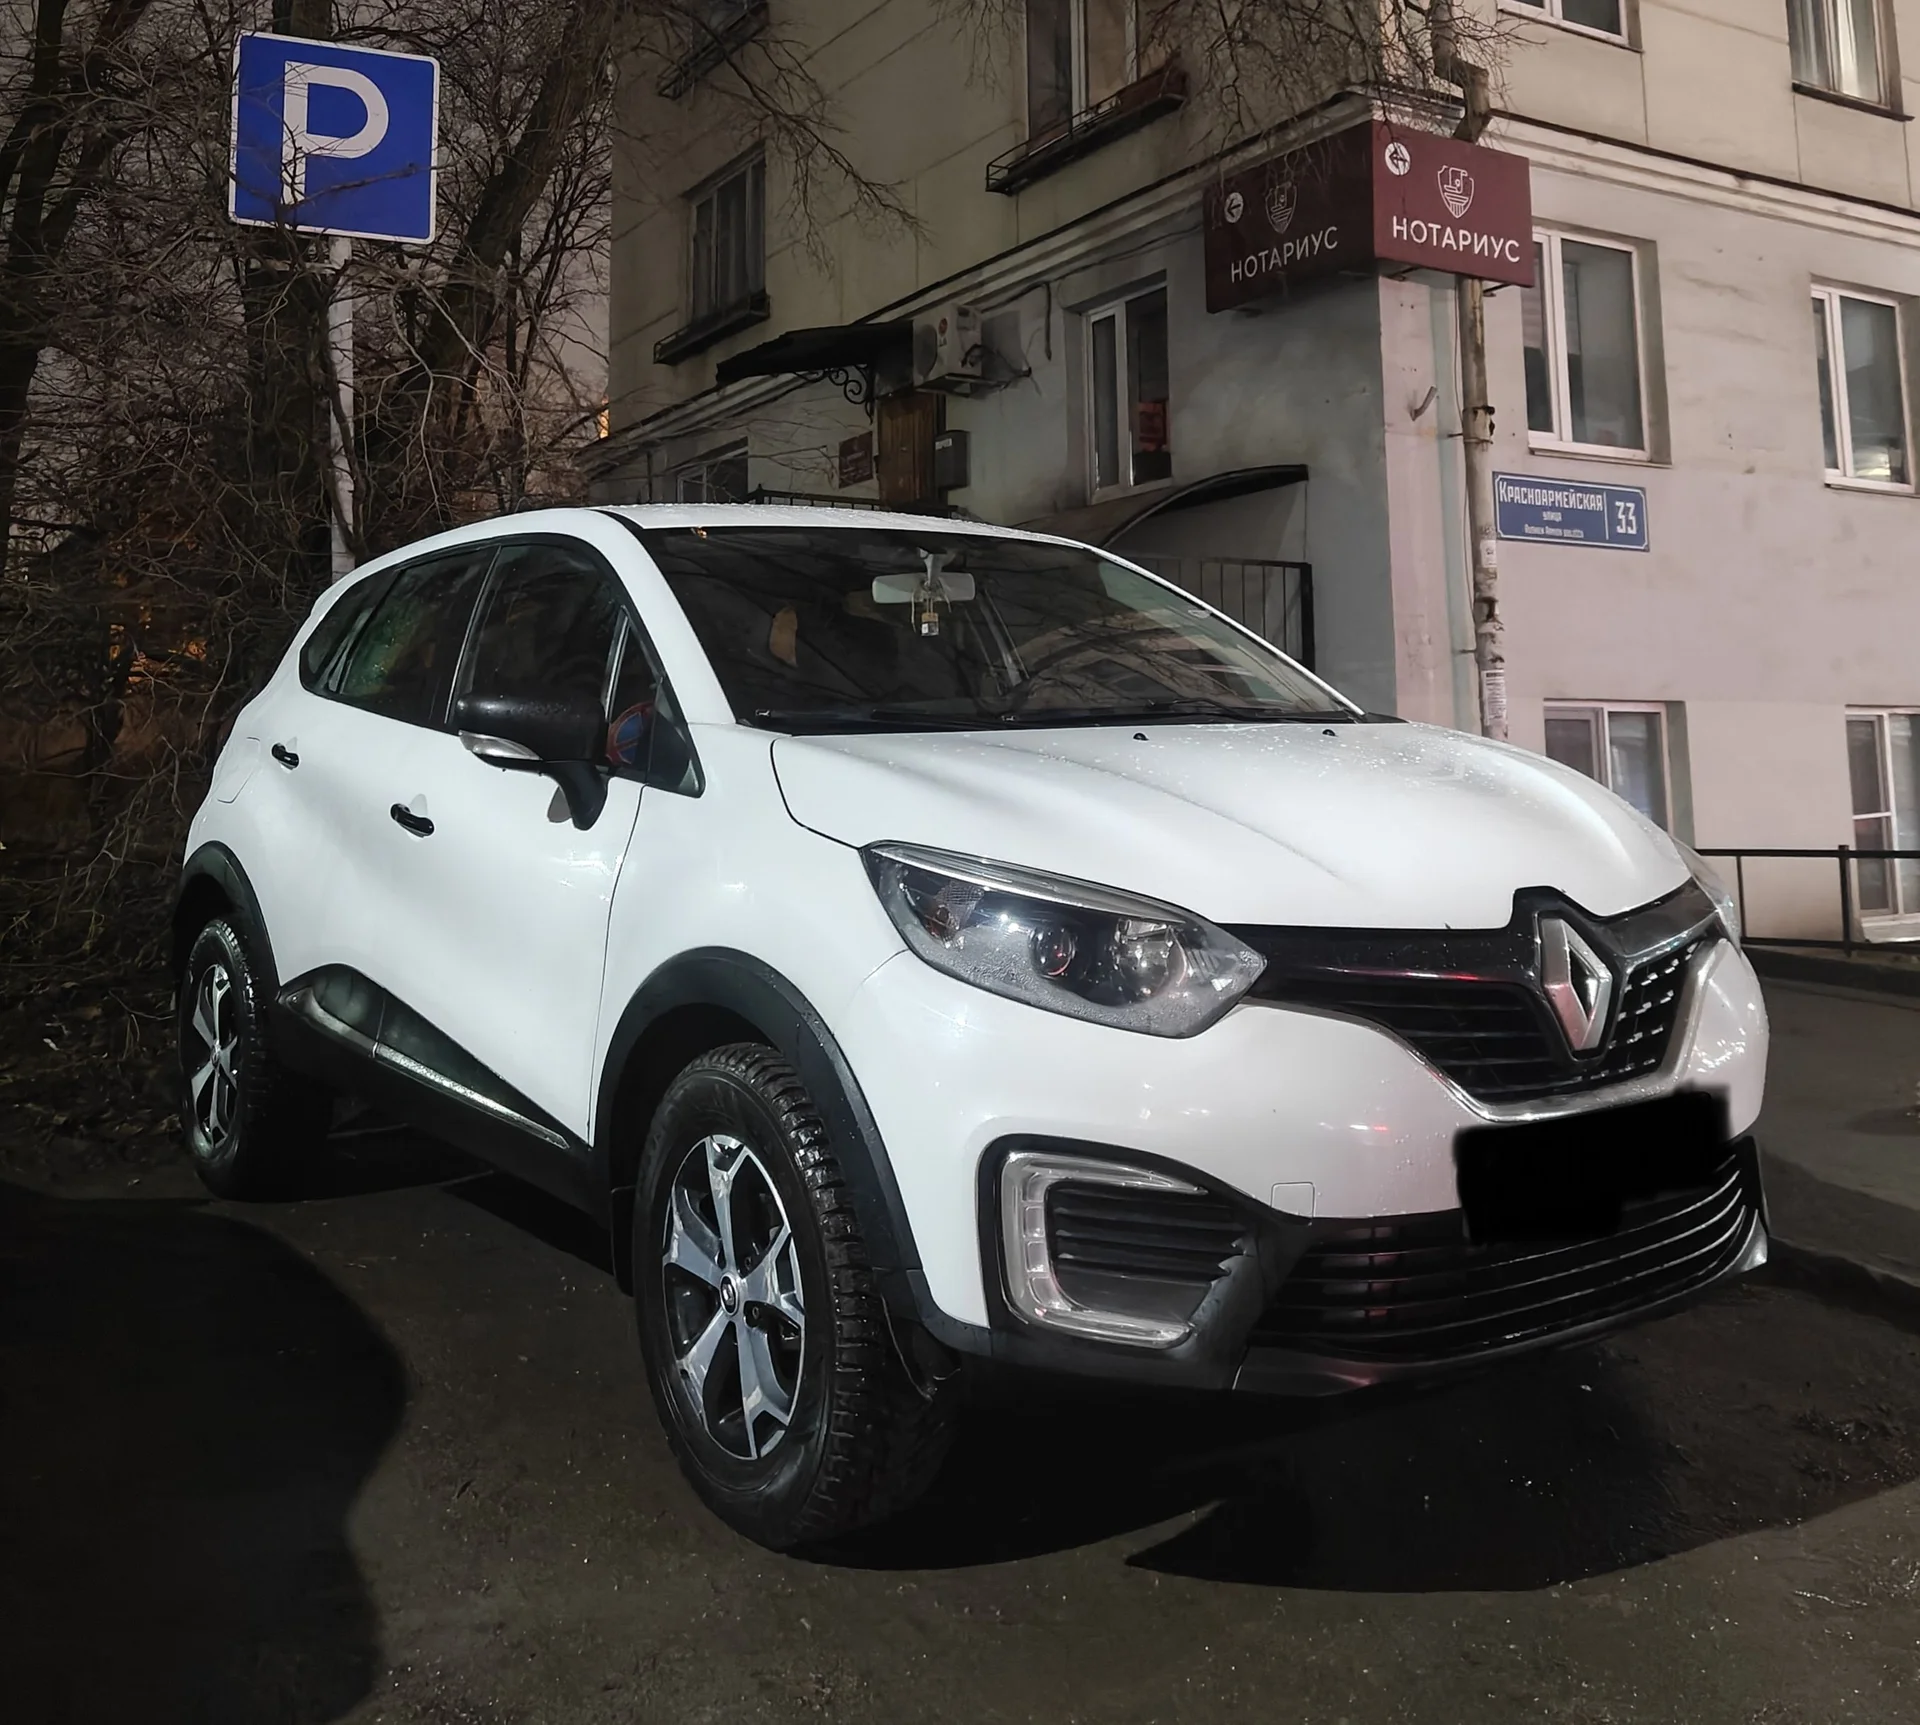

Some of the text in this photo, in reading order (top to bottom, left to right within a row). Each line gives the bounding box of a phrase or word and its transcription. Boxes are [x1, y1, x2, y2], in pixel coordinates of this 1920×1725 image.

[281, 60, 389, 205] P
[1230, 226, 1338, 283] НОТАРИУС
[1393, 215, 1520, 263] НОТАРИУС
[1615, 501, 1637, 535] 33
